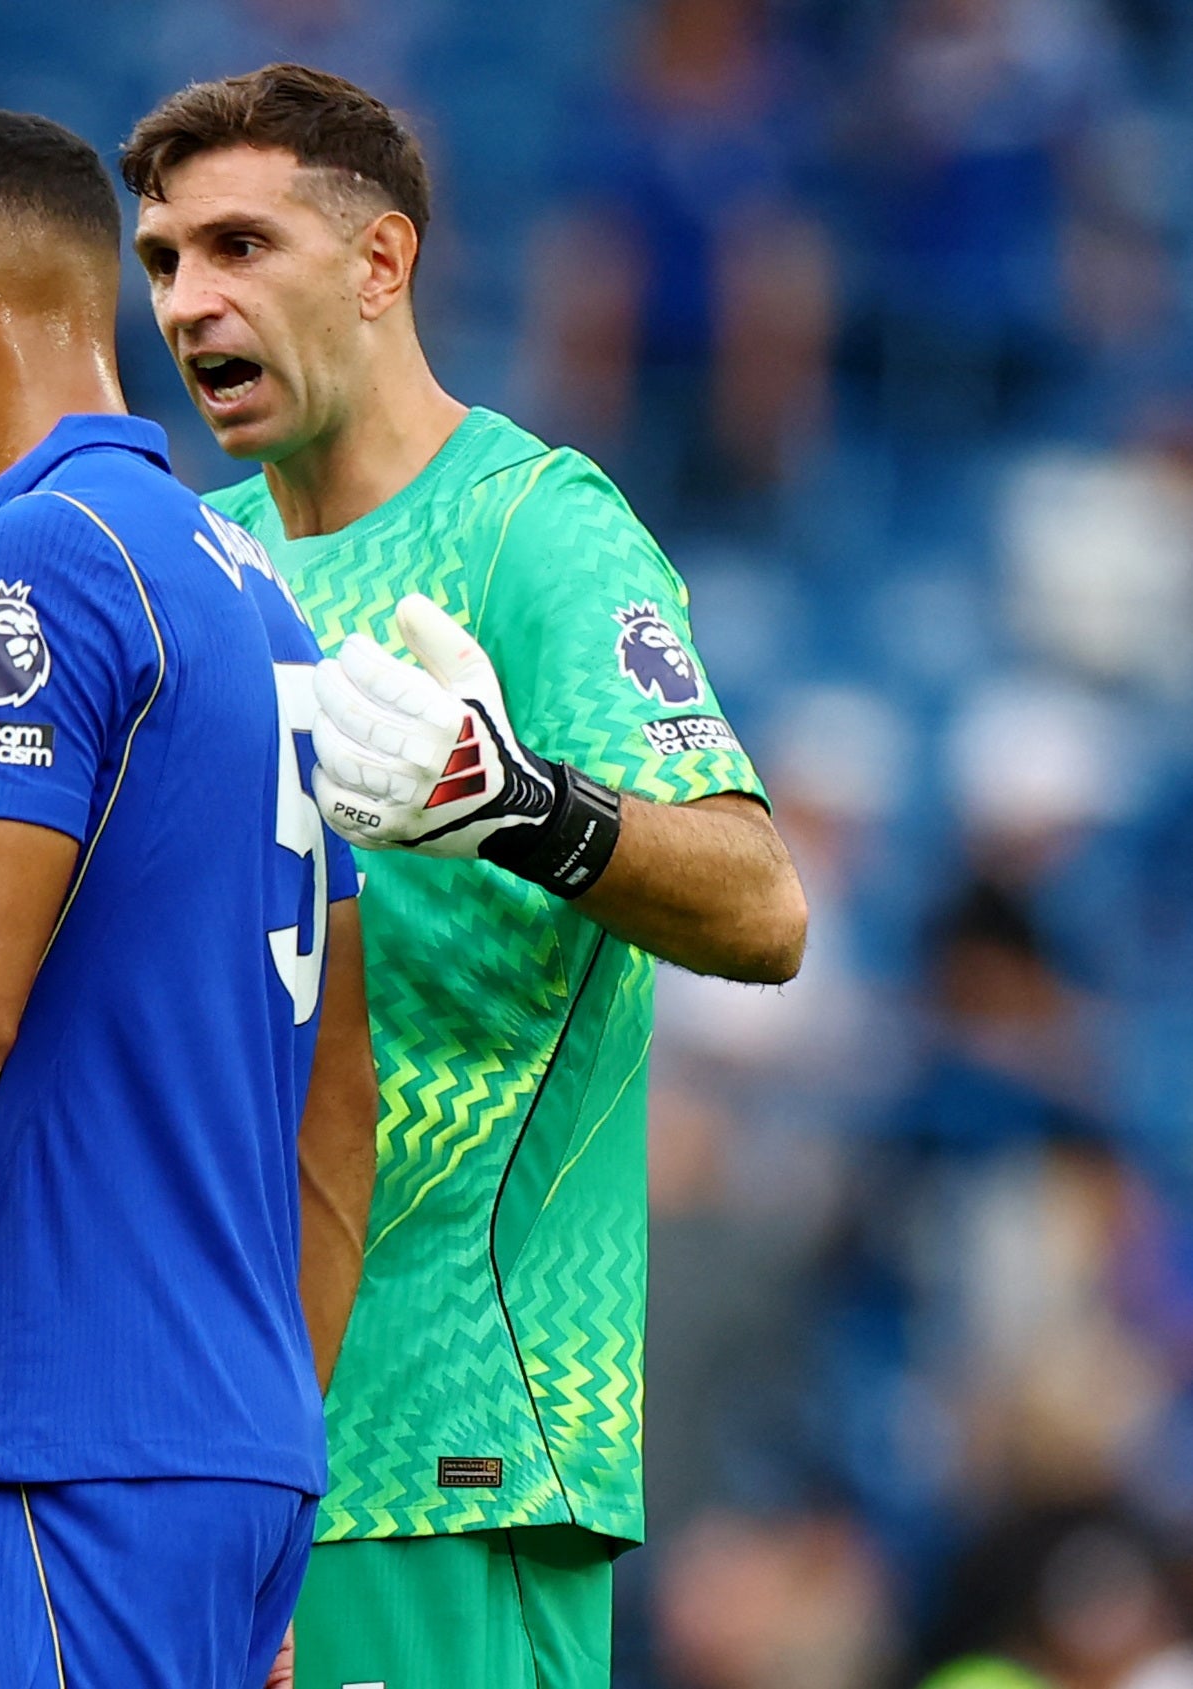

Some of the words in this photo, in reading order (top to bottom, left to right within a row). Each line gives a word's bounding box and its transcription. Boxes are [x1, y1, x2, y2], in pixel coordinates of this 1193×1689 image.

[641, 721, 678, 742] No
[677, 718, 729, 737] room
[649, 737, 684, 756] for
[334, 801, 382, 829] PRED
